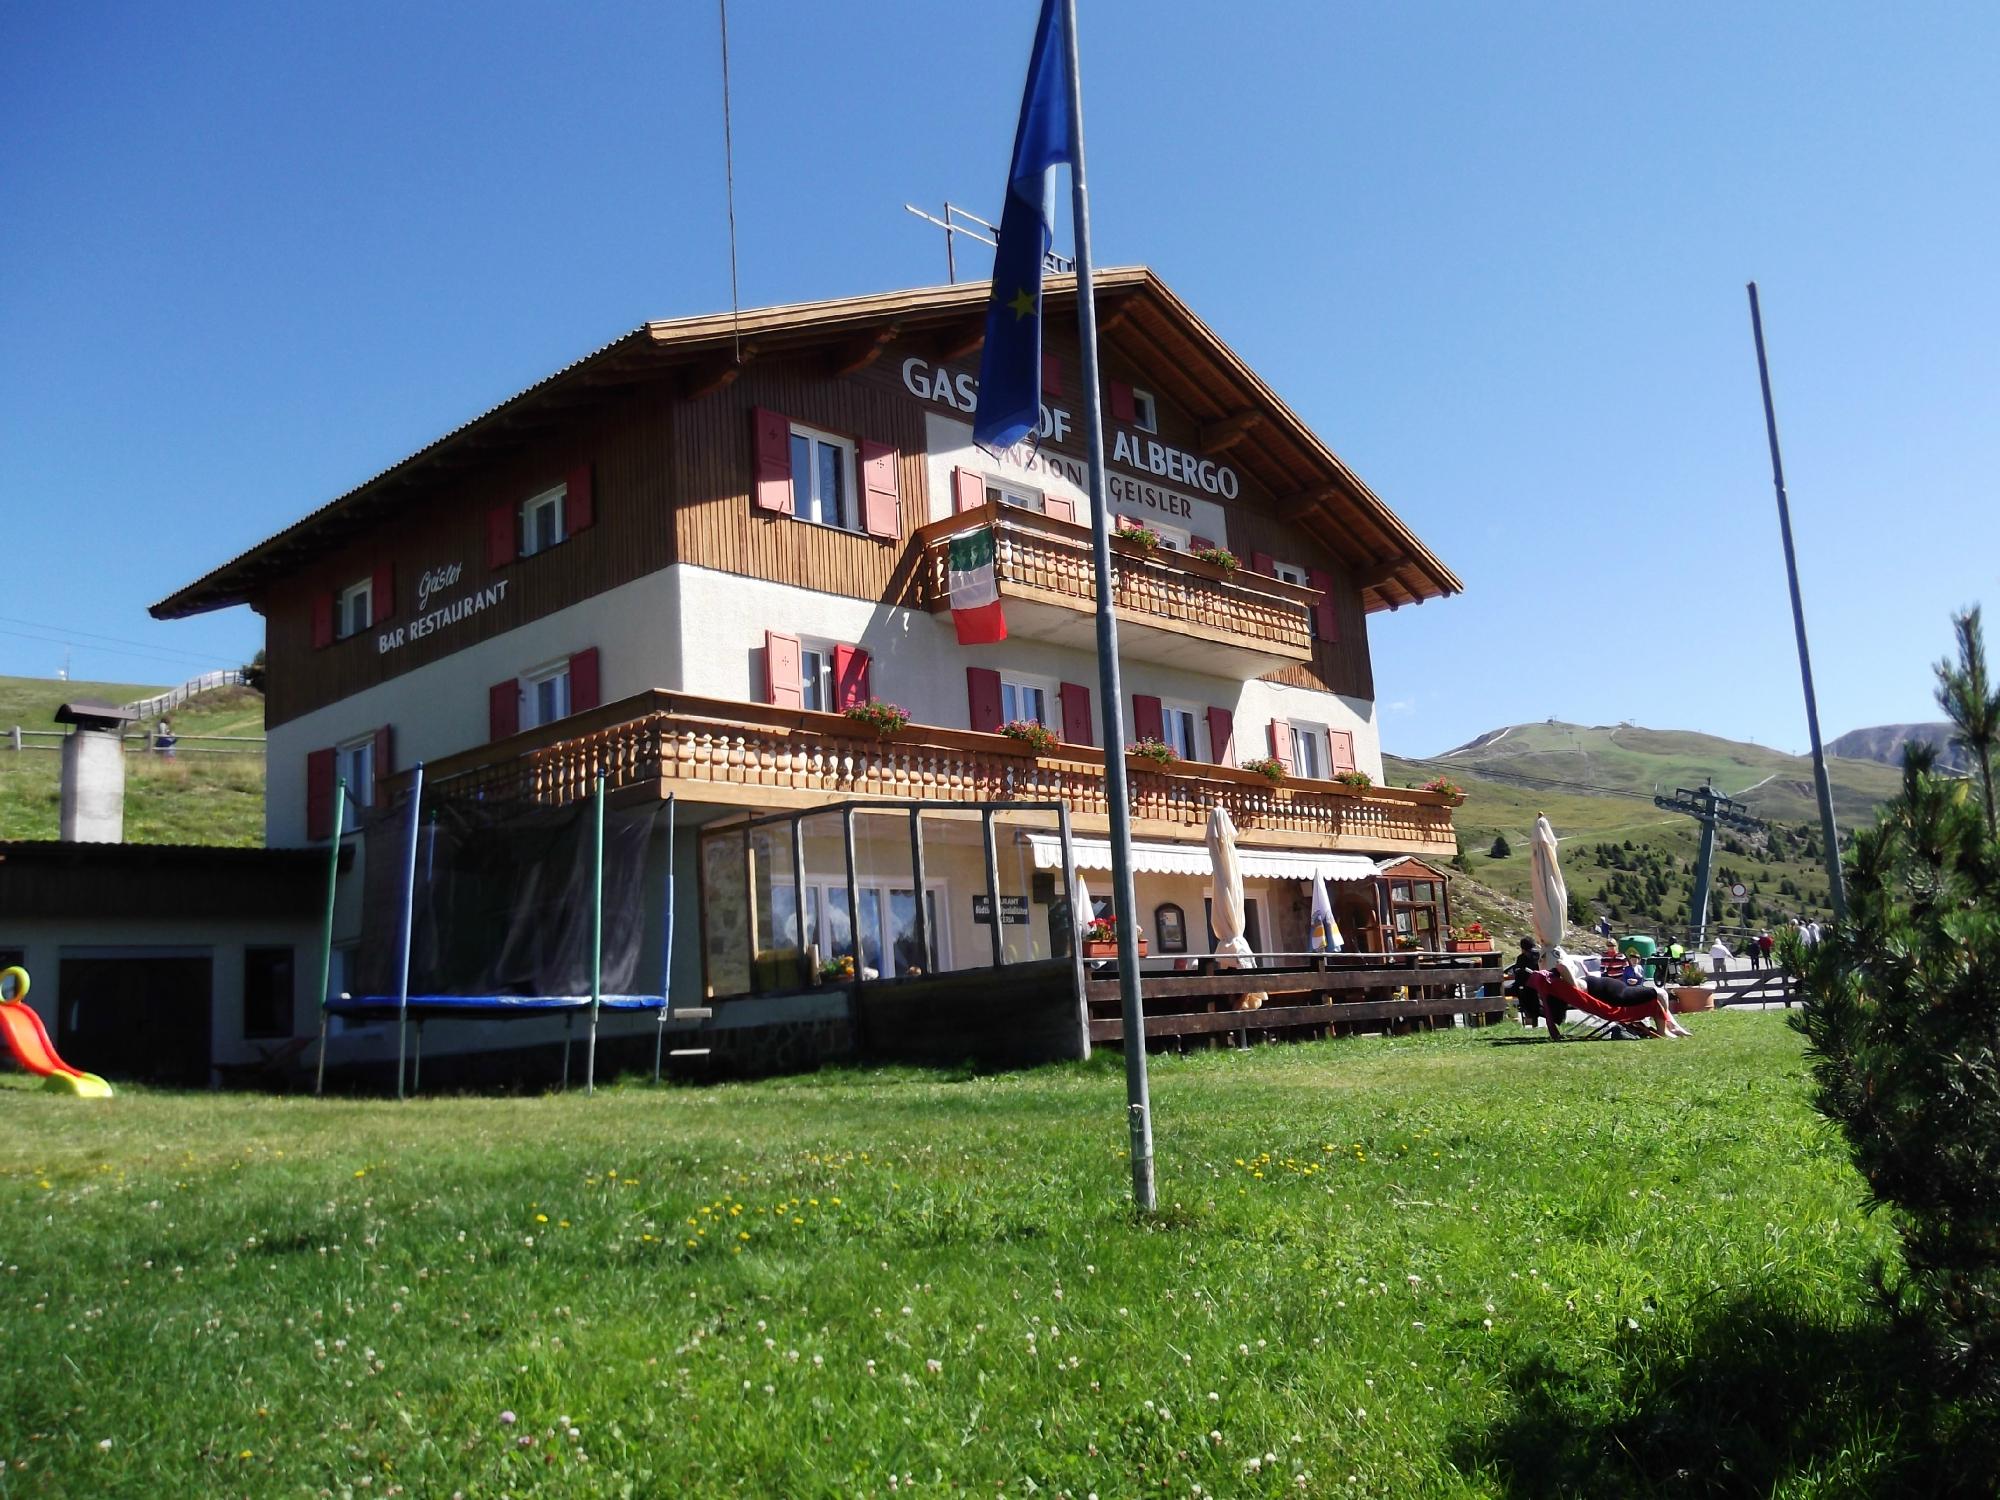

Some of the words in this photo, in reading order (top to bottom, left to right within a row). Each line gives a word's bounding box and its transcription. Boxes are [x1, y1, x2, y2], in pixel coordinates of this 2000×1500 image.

[902, 356, 1072, 443] GASOF
[1113, 431, 1239, 500] ALBERGO
[975, 445, 1083, 488] NSION
[1109, 476, 1193, 520] GEISLER
[379, 627, 405, 655] BAR
[410, 580, 509, 641] RESTAURANT
